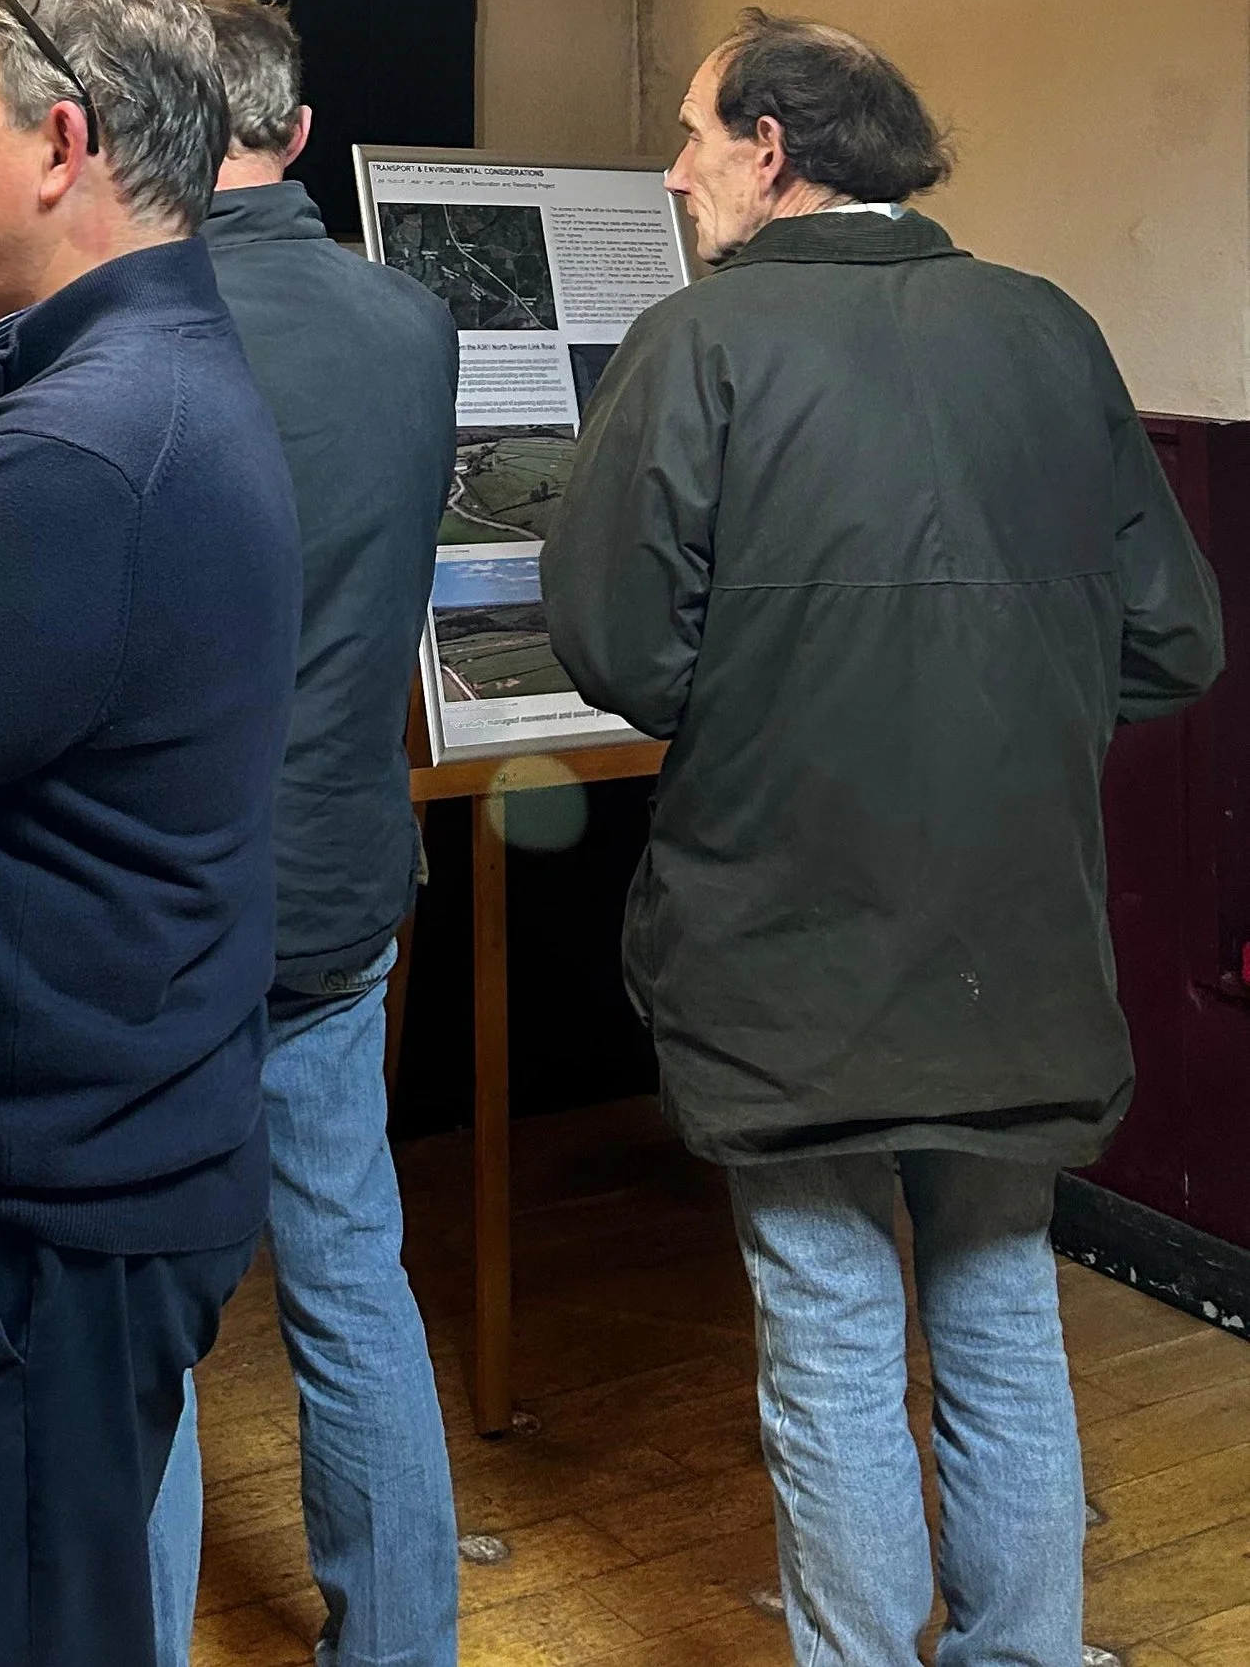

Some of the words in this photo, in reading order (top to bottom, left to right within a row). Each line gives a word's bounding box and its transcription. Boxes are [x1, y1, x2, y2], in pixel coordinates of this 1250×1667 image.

[373, 164, 415, 172] TRANSPORT
[424, 166, 482, 175] ENVIRONMENTAL
[484, 168, 544, 176] CONSIDERATIONS
[559, 711, 572, 719] and
